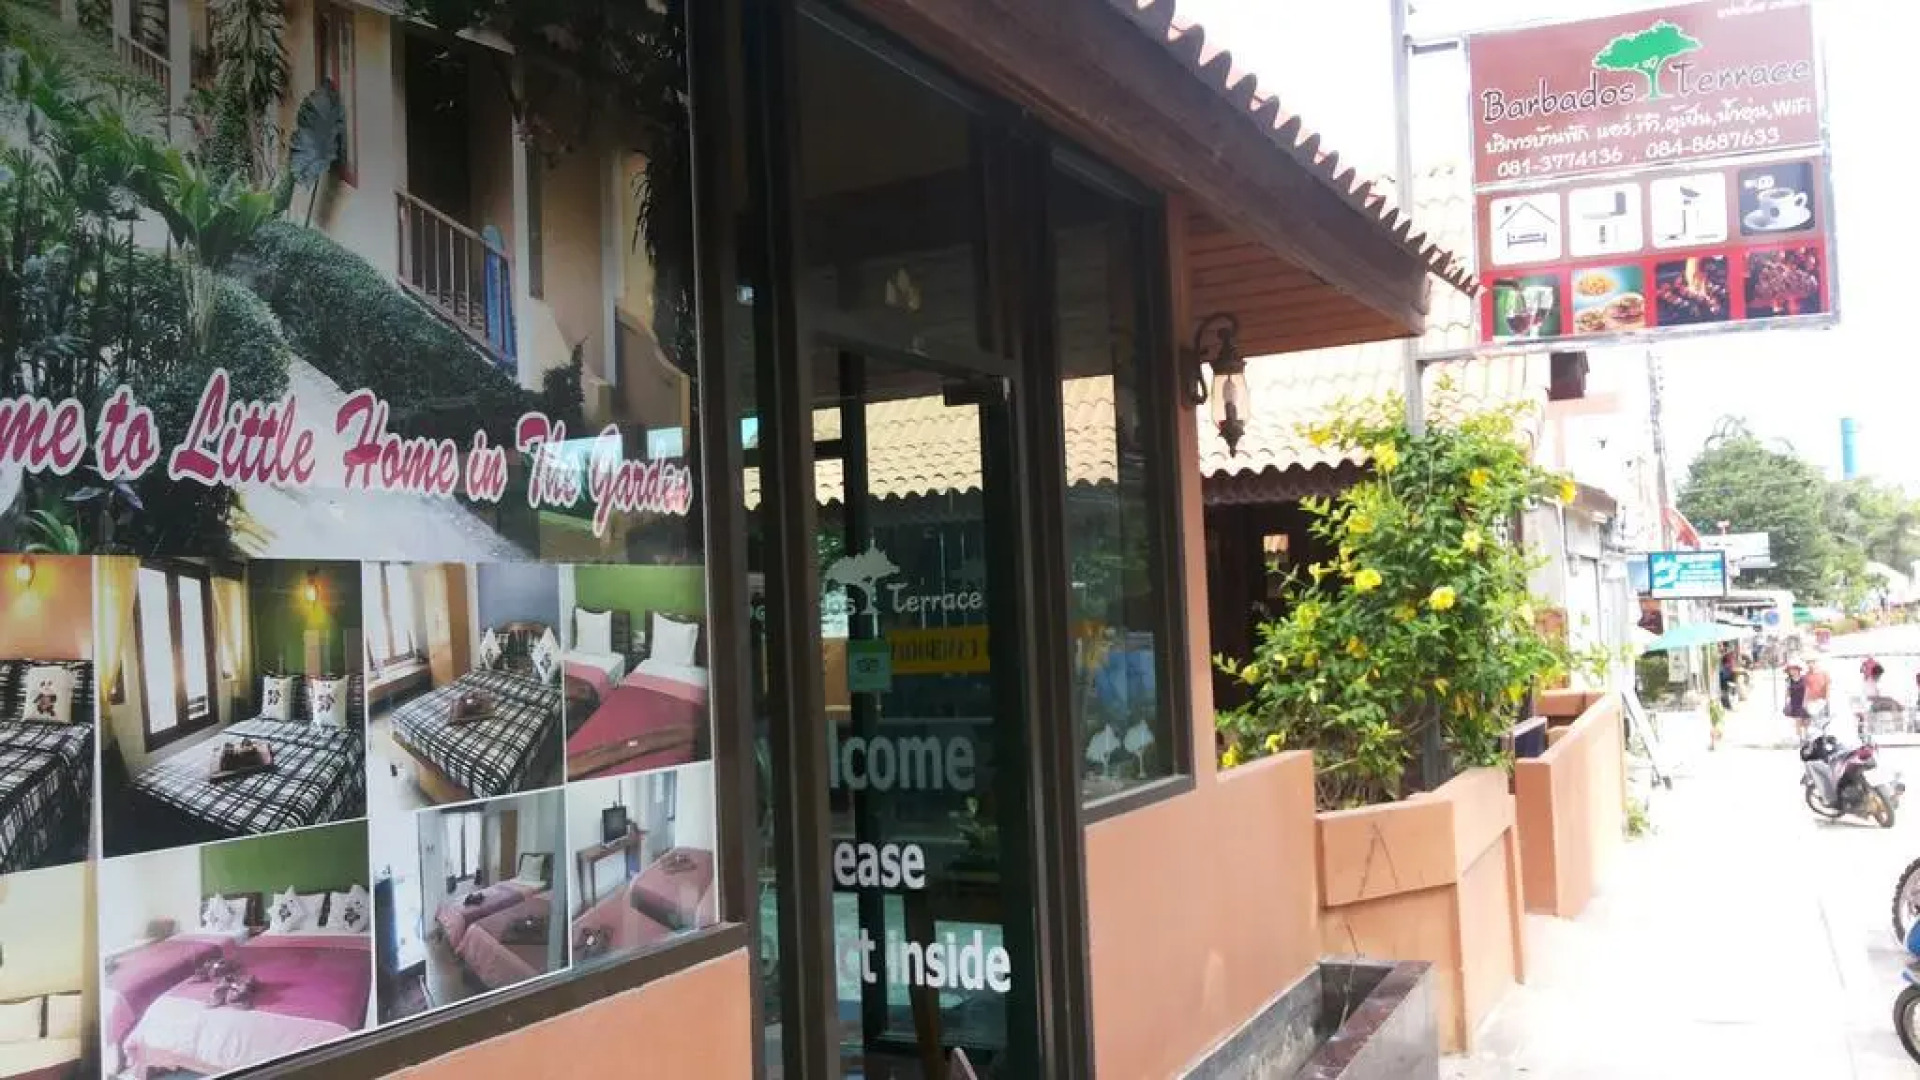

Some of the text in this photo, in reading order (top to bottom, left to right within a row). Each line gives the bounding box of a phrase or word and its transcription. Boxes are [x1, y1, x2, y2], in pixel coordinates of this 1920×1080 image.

[1482, 59, 1811, 124] Barbados Terrace
[1497, 147, 1623, 177] 081-3774136
[1645, 126, 1781, 159] 084-8687633
[95, 384, 160, 481] to
[168, 366, 316, 486] Little
[335, 387, 457, 497] Home
[466, 429, 508, 504] in
[516, 411, 582, 509] The
[590, 423, 693, 538] Garden
[886, 582, 985, 613] Terrace
[833, 842, 927, 890] ease
[886, 929, 1012, 993] inside
